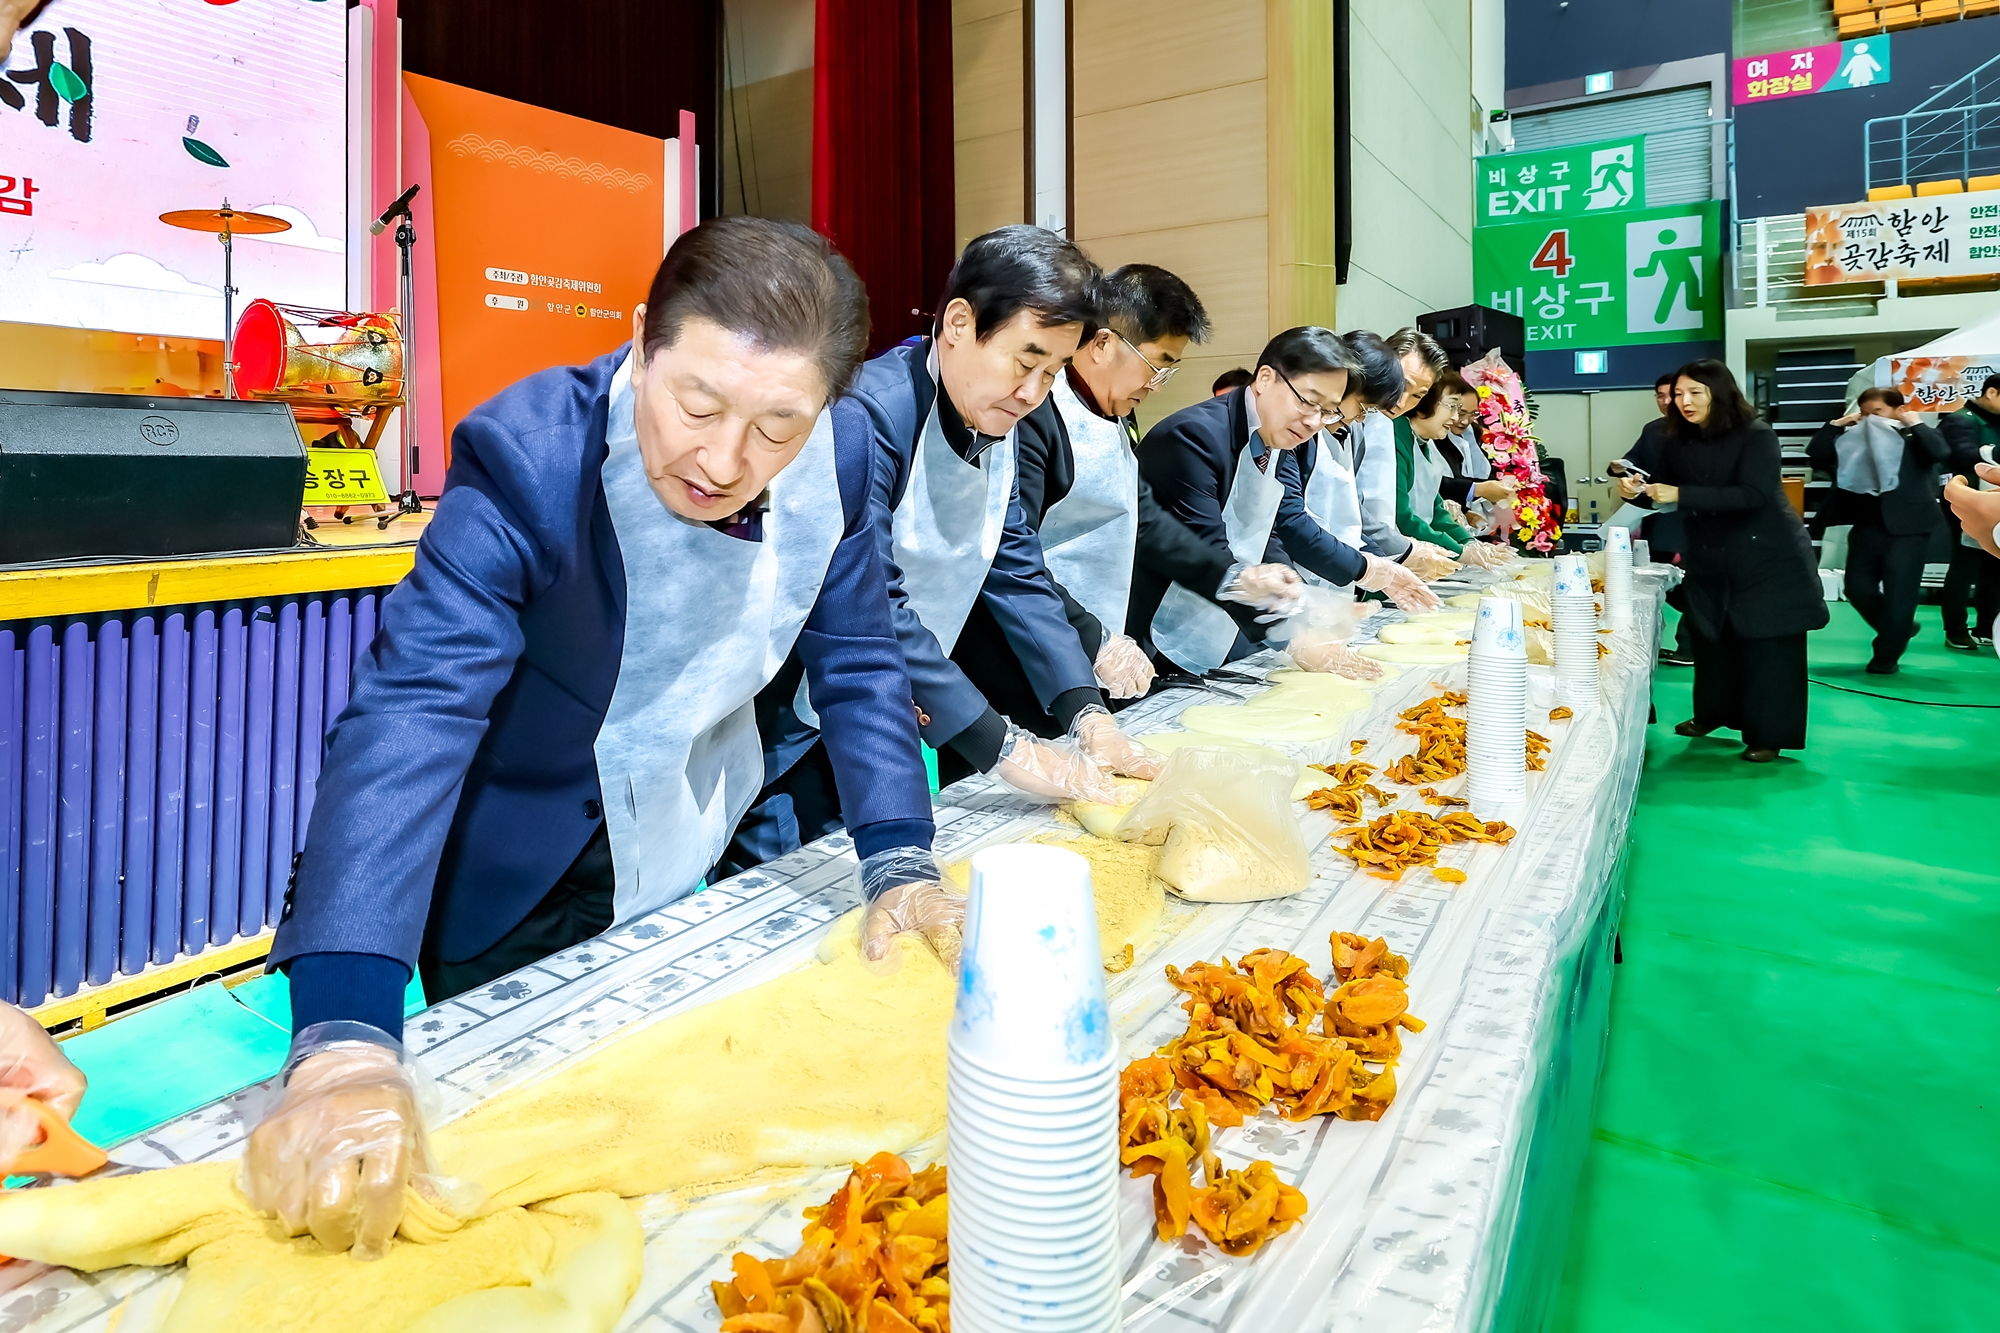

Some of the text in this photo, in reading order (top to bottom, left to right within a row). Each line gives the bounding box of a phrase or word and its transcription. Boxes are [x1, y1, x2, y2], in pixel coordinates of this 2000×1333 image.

[1747, 72, 1813, 98] 화장실
[1488, 185, 1571, 216] EXIT
[1530, 229, 1575, 278] 4
[1840, 238, 1949, 271] 곶감축제
[492, 270, 602, 295] 주최/주관 함안곶감축제위원회
[589, 307, 622, 321] 함안군의회
[1491, 282, 1615, 320] 비상구
[1526, 323, 1577, 341] EXIT
[142, 424, 175, 438] RCF
